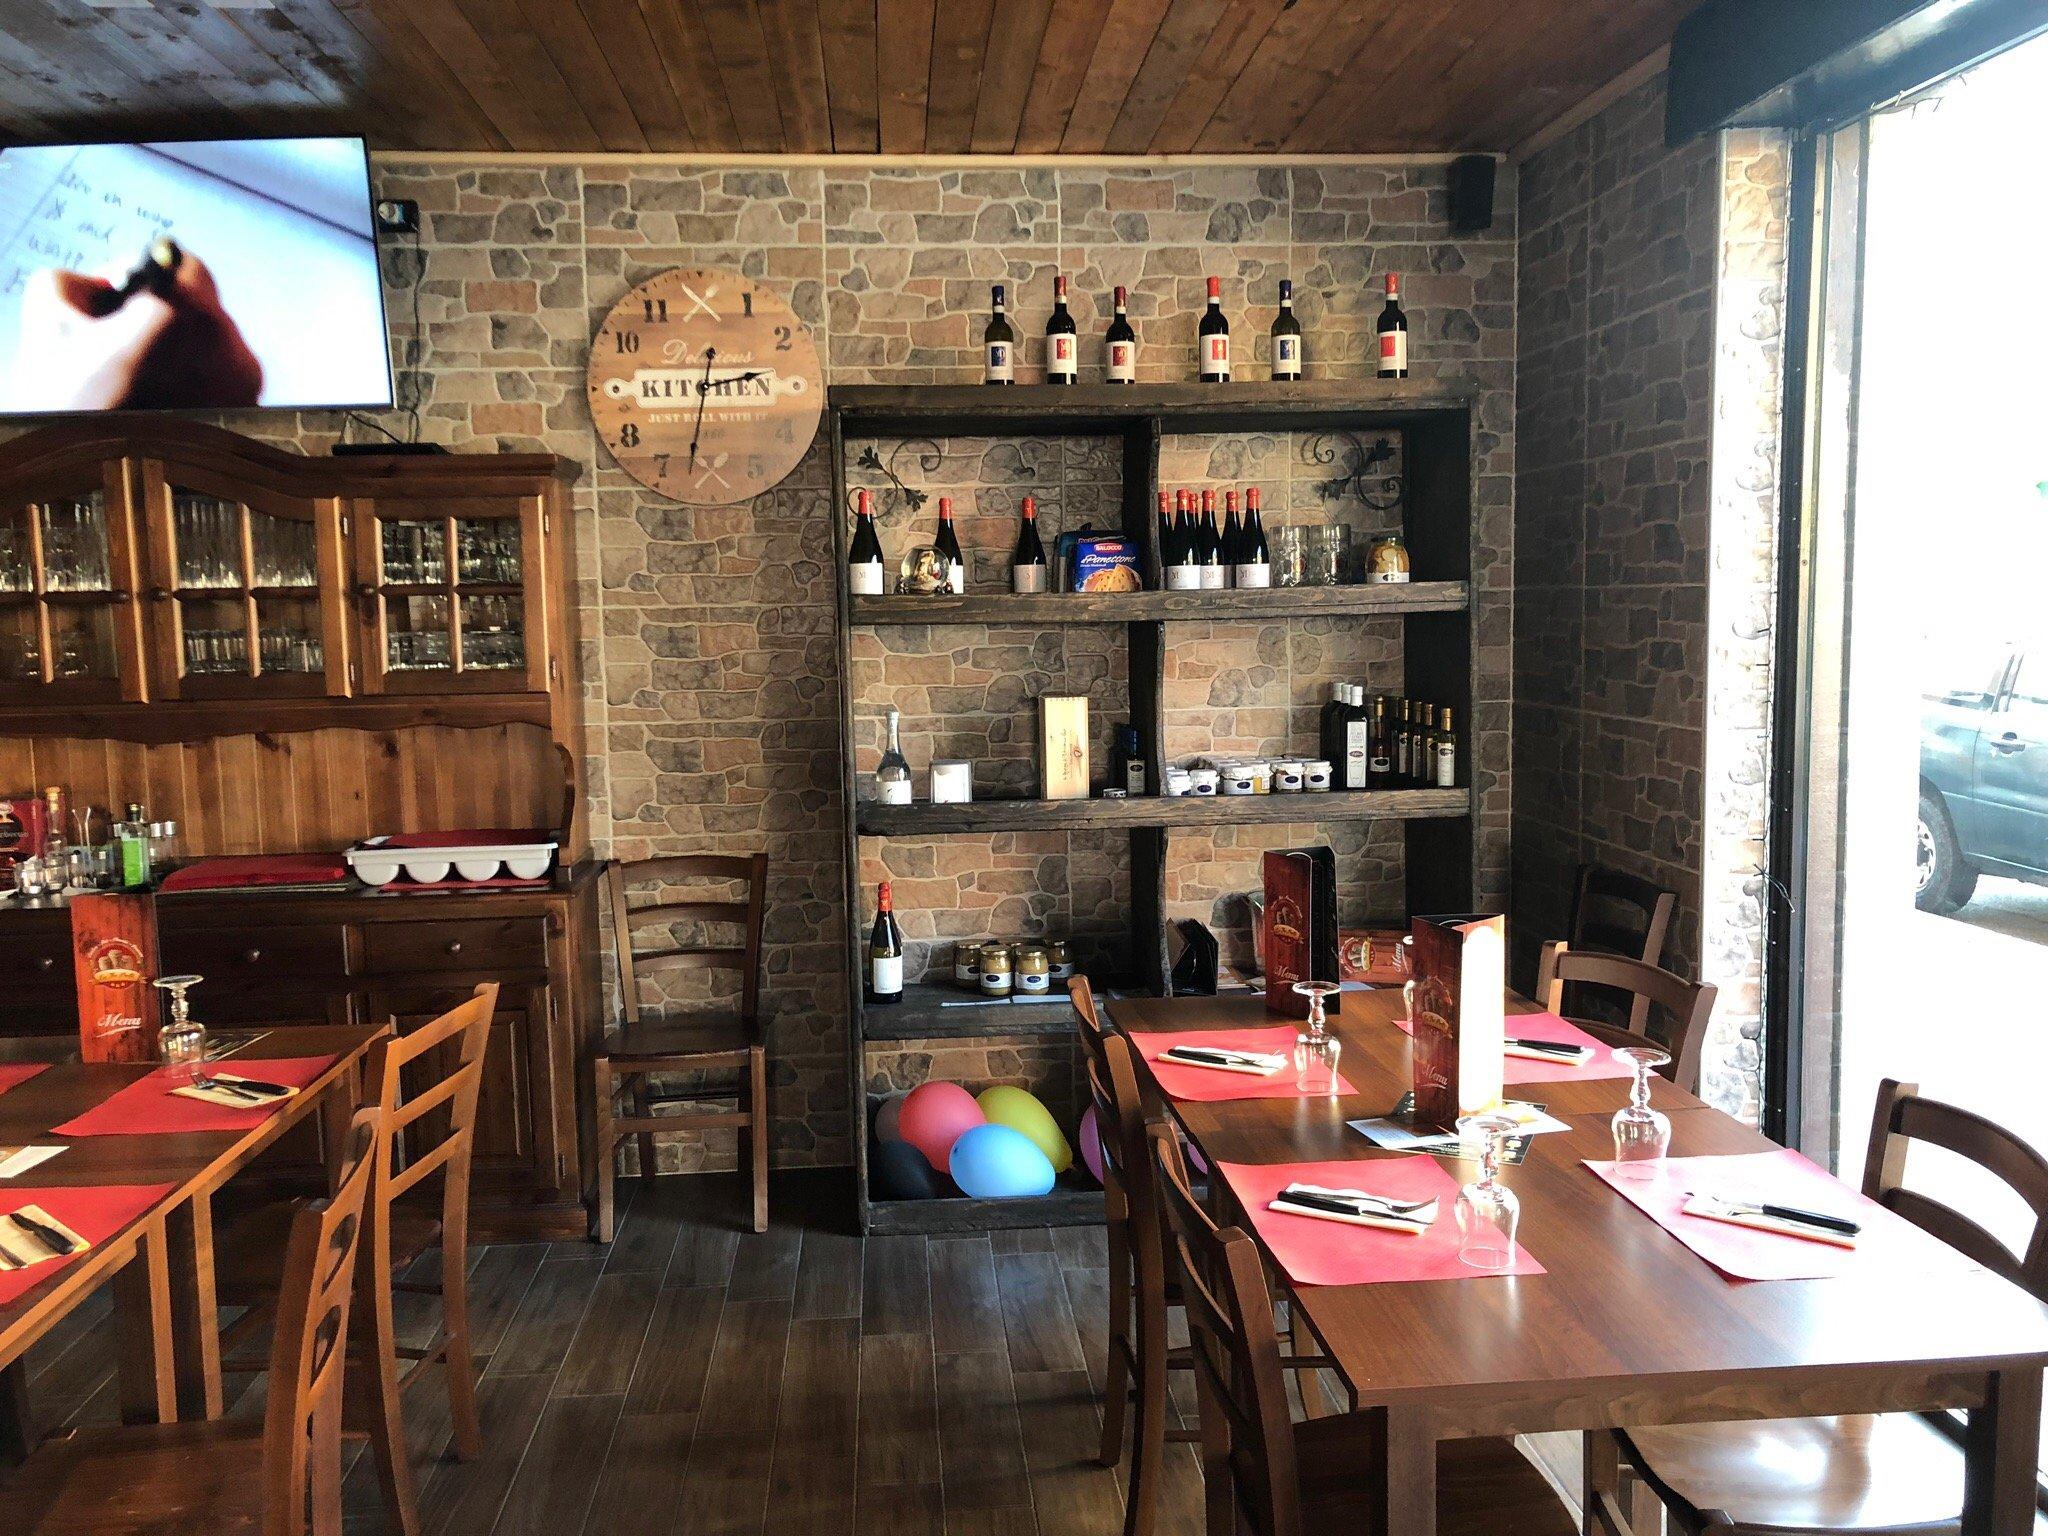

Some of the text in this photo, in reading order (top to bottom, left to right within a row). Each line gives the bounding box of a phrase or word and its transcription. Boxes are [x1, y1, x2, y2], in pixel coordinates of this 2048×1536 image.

[643, 298, 669, 323] 11
[616, 331, 640, 354] 10
[774, 326, 792, 350] 2
[661, 339, 754, 364] Delcious
[641, 378, 771, 398] KITCHEN
[620, 423, 640, 448] 8
[653, 453, 670, 478] 7
[1391, 943, 1402, 972] Menu
[1274, 966, 1300, 981] Menu
[97, 1012, 142, 1027] Menu
[1422, 1065, 1448, 1085] Menu
